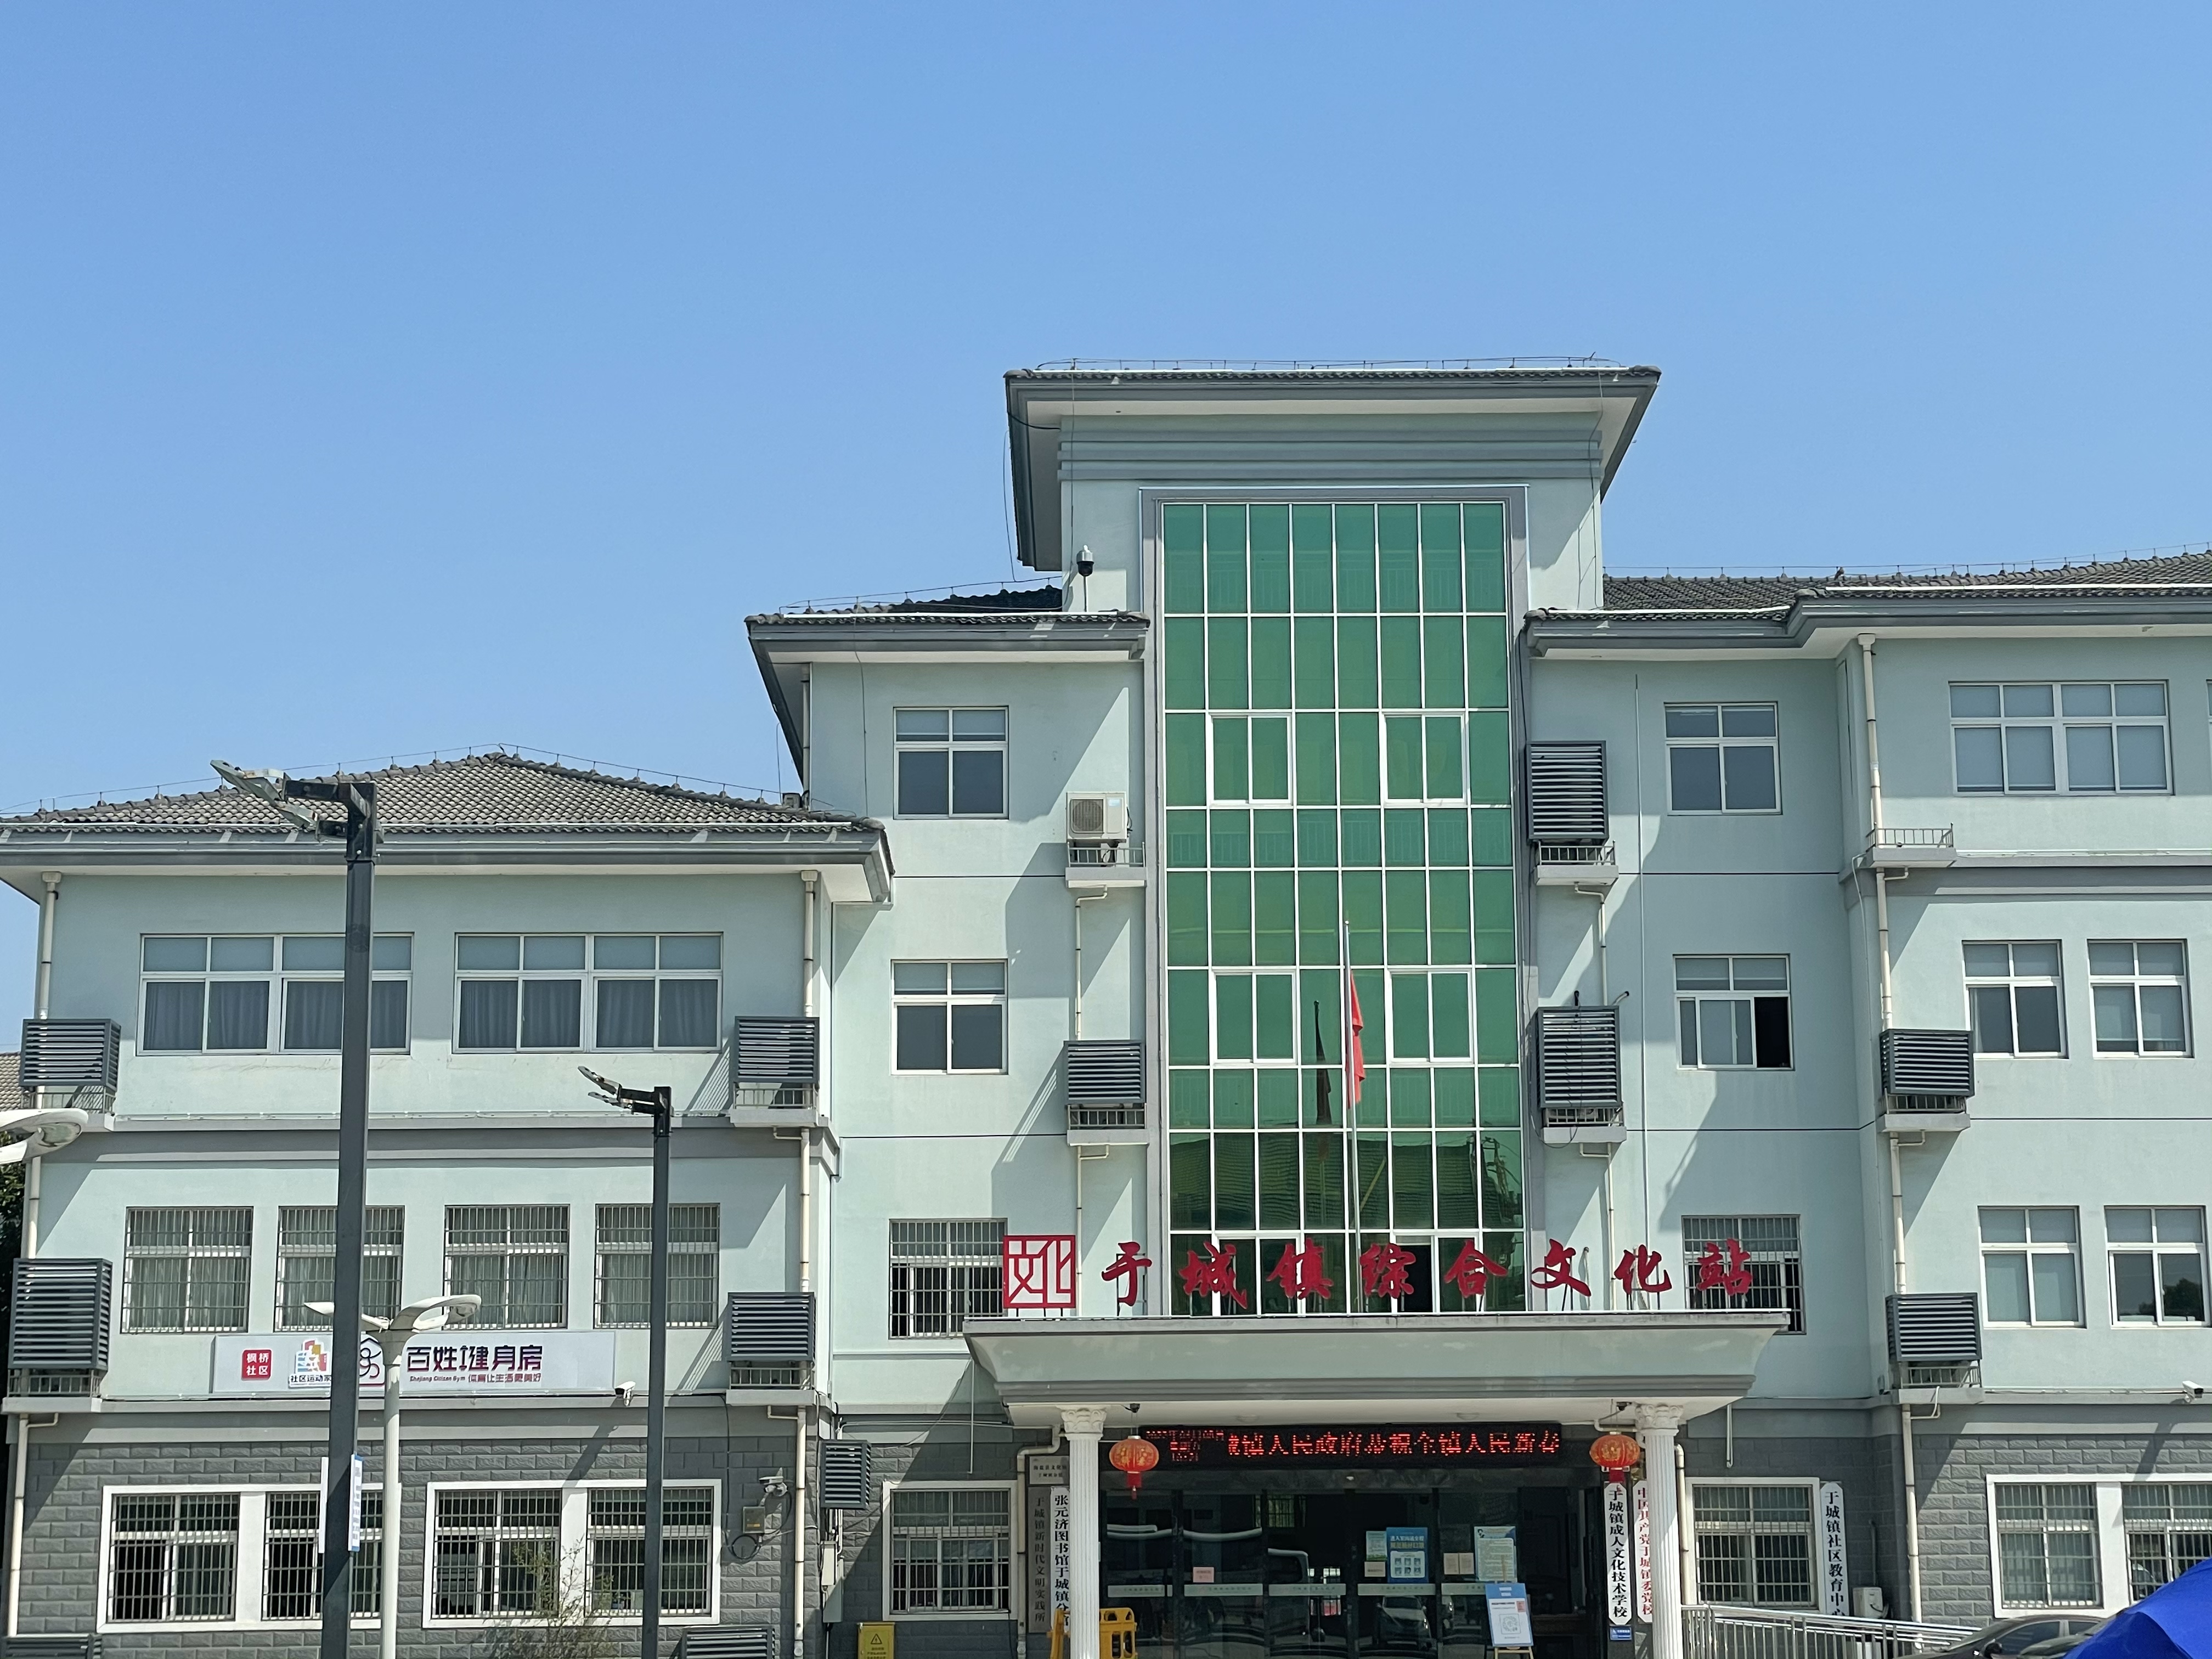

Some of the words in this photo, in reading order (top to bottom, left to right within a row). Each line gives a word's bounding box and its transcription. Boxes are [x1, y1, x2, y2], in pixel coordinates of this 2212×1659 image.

[1102, 1238, 1752, 1309] 于城镇综合文化站
[246, 1365, 269, 1376] 社区
[407, 1345, 543, 1372] 百姓健身房
[1609, 1491, 1628, 1618] 于城镇成人文化技术学校
